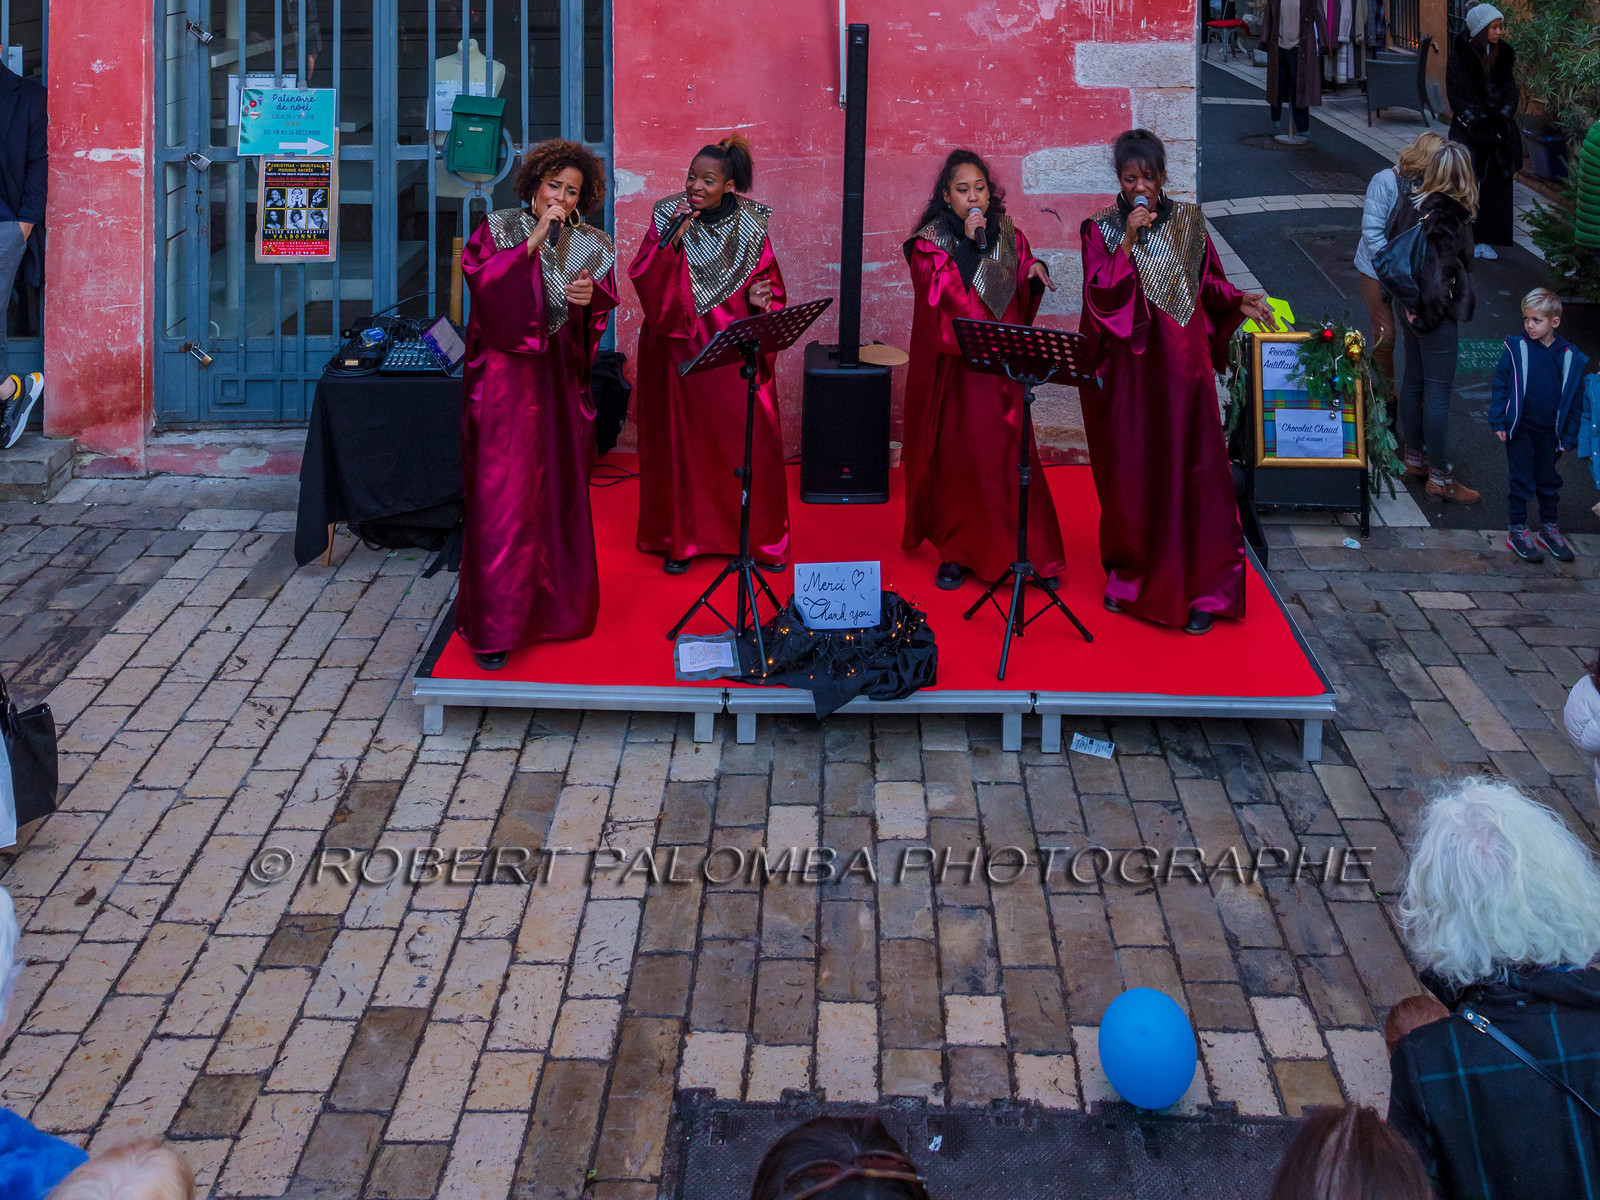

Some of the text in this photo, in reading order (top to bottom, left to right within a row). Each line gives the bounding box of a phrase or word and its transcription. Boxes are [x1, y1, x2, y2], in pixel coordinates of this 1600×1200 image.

[272, 93, 316, 103] Patinoire
[276, 102, 289, 111] de
[1281, 423, 1340, 434] Chocolat Chaud
[803, 571, 846, 592] Merci
[802, 596, 873, 626] Thank you
